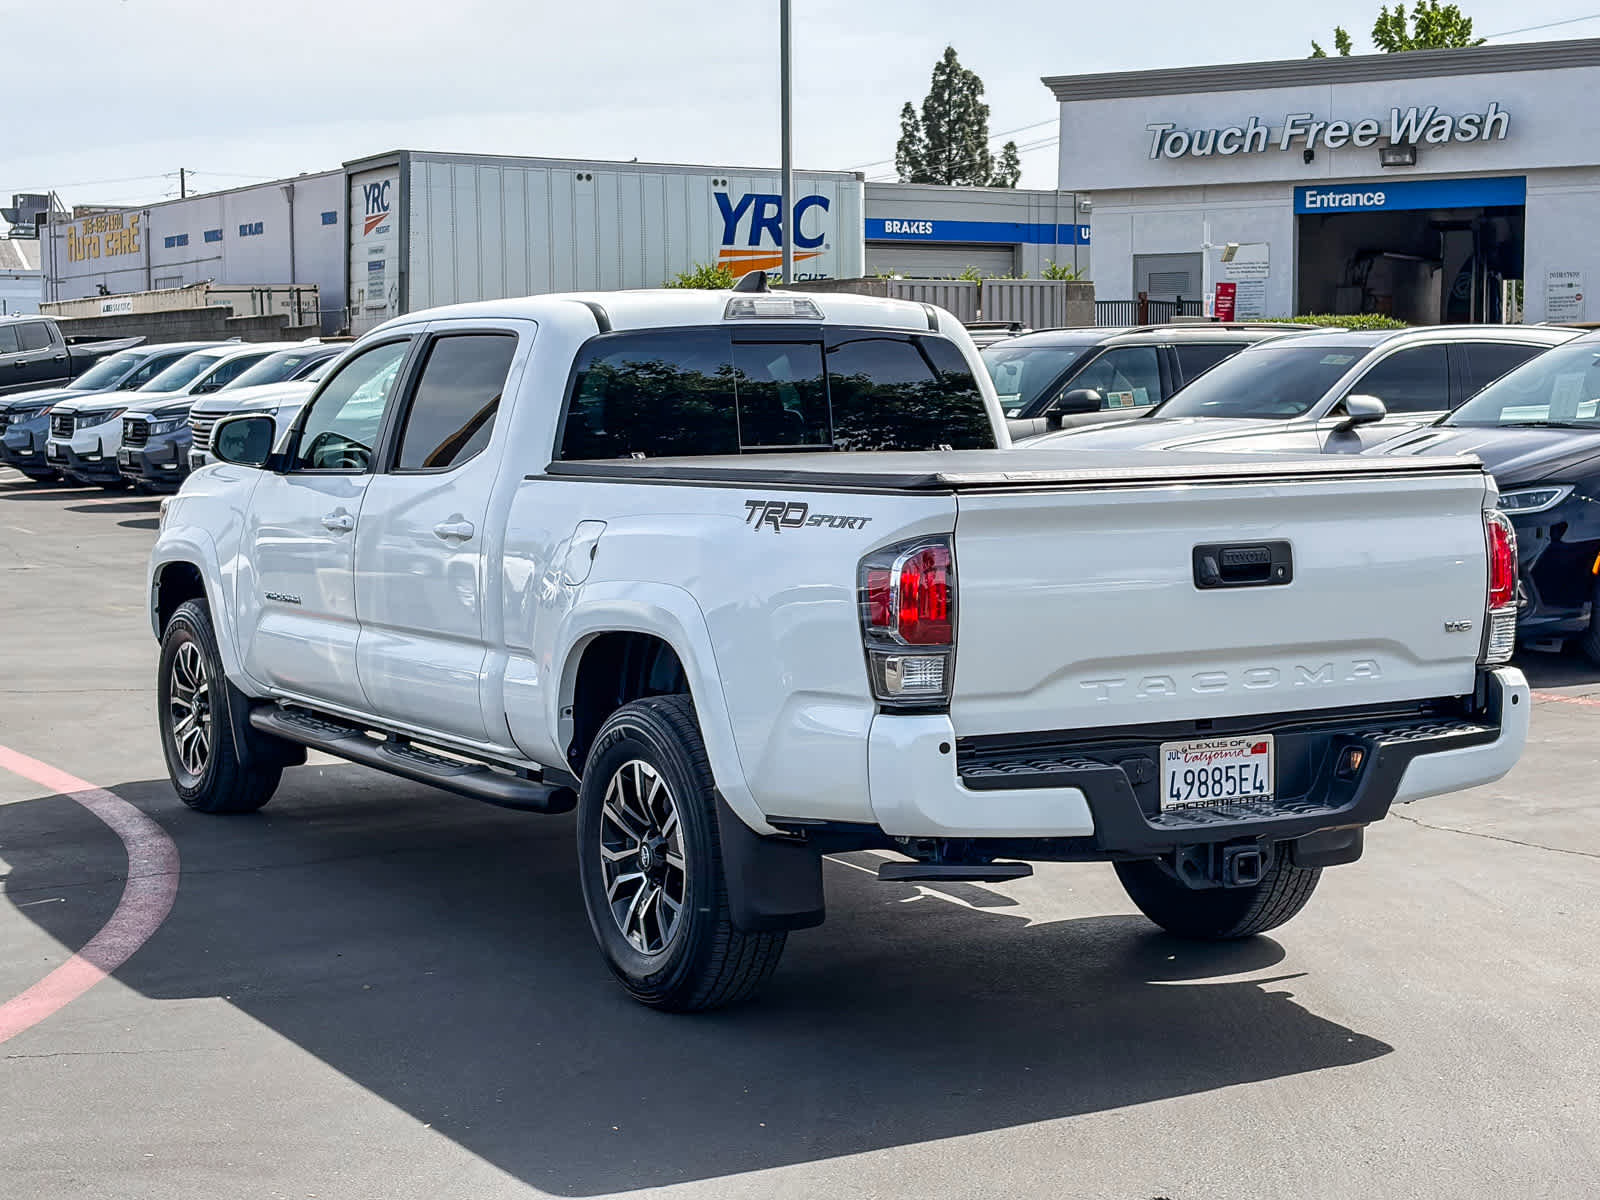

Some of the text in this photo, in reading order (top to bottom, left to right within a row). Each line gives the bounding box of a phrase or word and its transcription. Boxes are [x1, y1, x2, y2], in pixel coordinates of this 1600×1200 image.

[1145, 102, 1511, 160] Touch Free Wash
[363, 180, 391, 215] YRC
[1304, 188, 1386, 209] Entrance
[713, 192, 831, 249] YRC
[884, 220, 933, 234] BRAKES
[744, 499, 873, 533] TRD SPORT
[1079, 658, 1384, 702] TACOMA
[1167, 751, 1181, 761] JUL
[1184, 749, 1246, 766] California
[1187, 741, 1229, 751] LEXUS
[1230, 739, 1247, 748] OF
[1169, 763, 1265, 801] 49885E4
